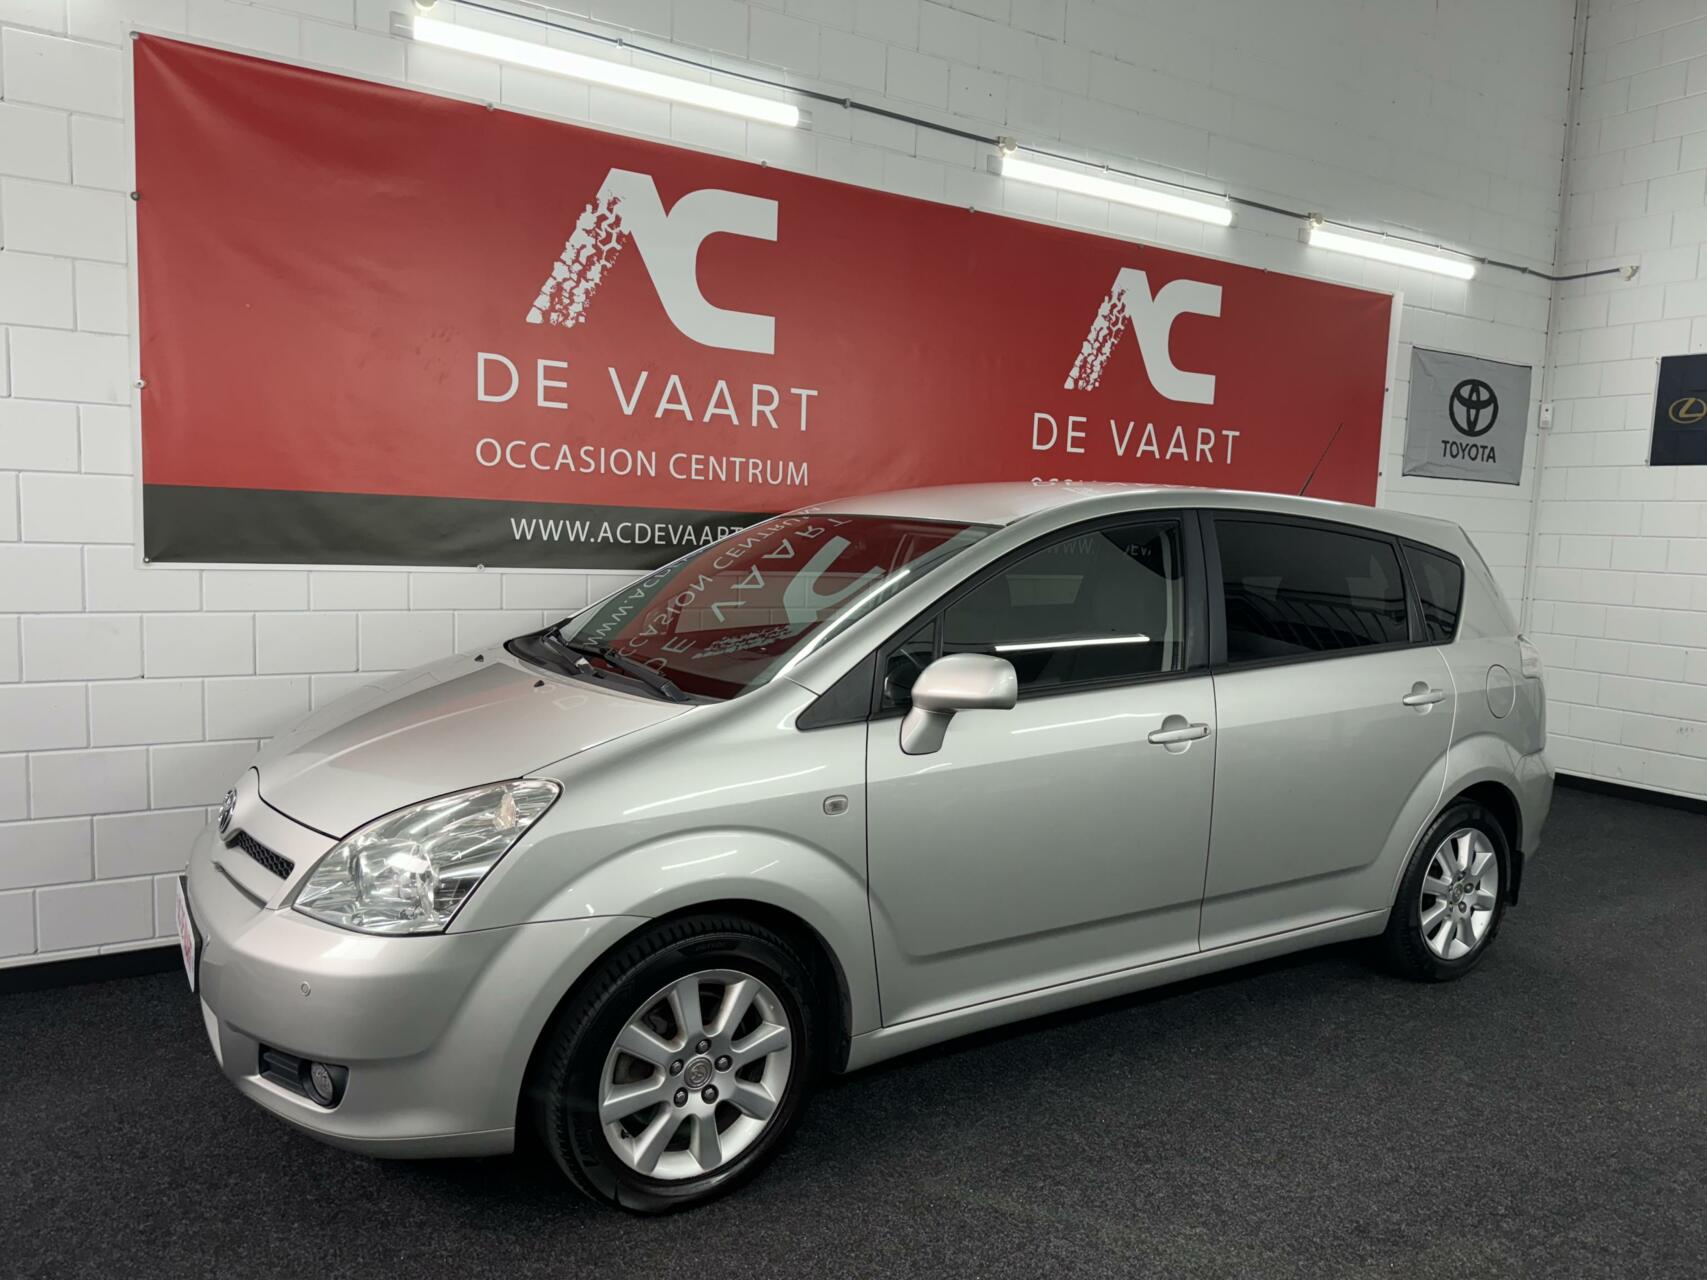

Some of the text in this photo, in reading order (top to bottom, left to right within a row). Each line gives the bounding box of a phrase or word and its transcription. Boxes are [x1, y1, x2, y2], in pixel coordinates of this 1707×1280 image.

[477, 351, 818, 432] DE VAART
[475, 437, 809, 487] OCCASION CENTRUM
[1031, 412, 1240, 465] DE VAART
[1441, 439, 1496, 463] TOYOTA
